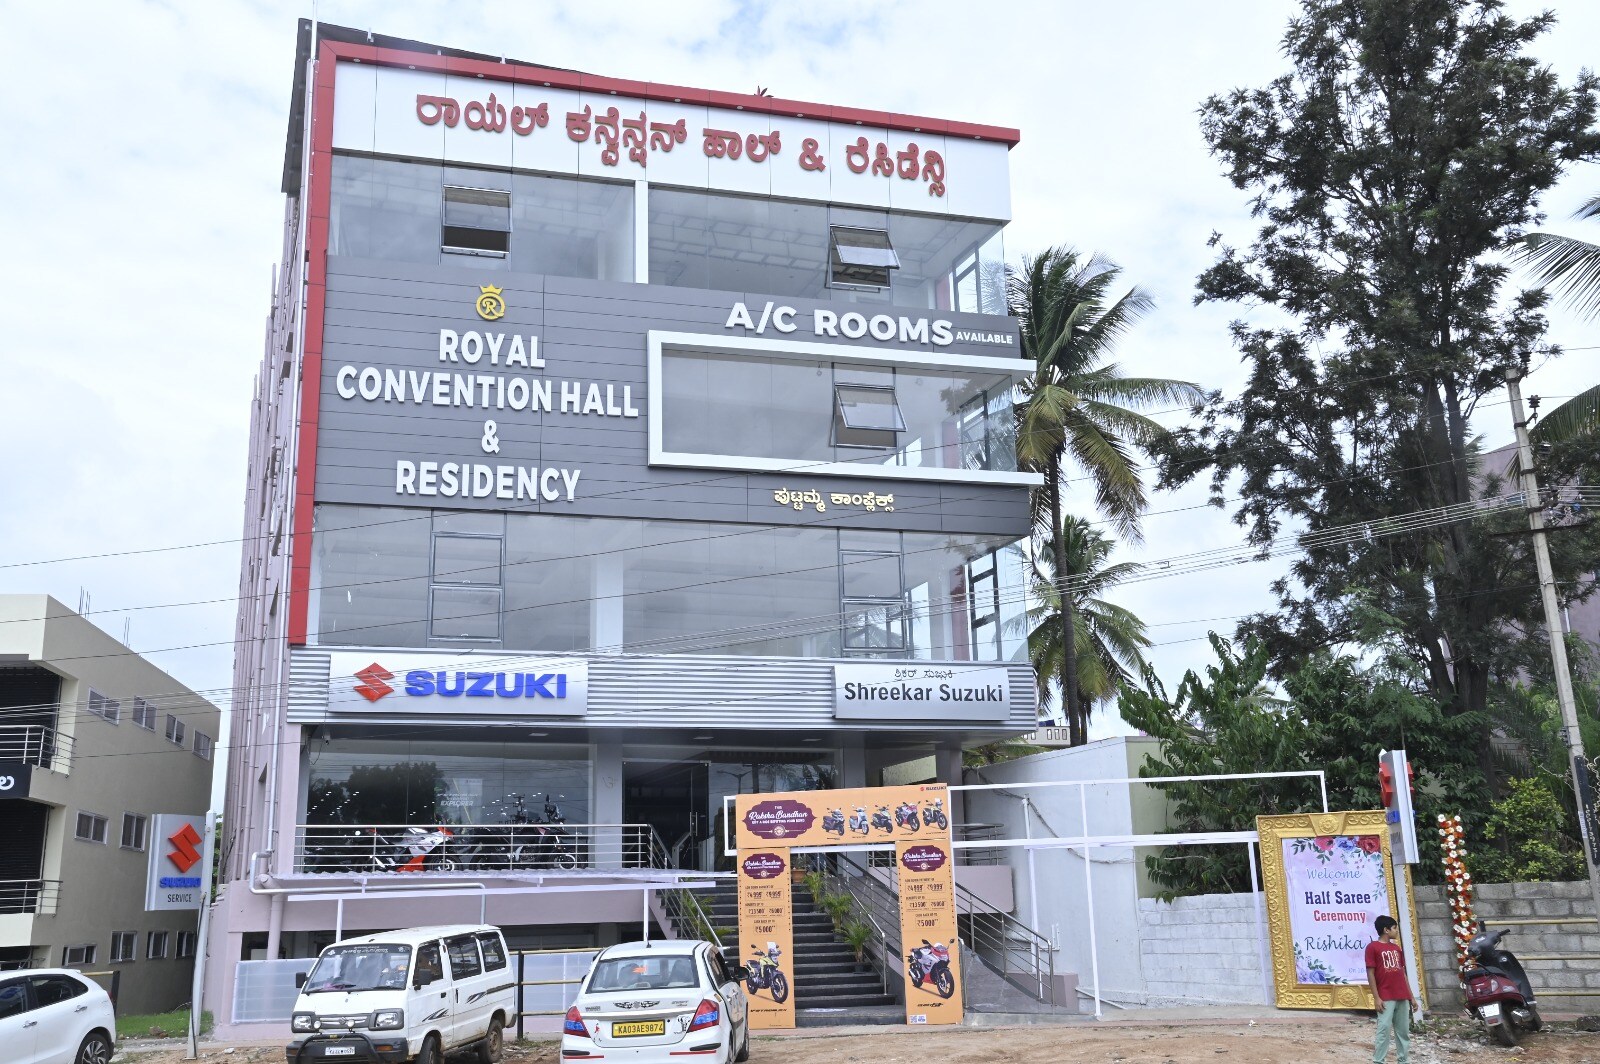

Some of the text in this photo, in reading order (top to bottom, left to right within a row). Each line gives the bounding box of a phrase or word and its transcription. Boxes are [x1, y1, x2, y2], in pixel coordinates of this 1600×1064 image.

[416, 93, 549, 136] ರಾಯಲ್
[703, 128, 781, 162] ಹಾಲ್
[799, 138, 826, 172] &
[846, 136, 945, 197] ರೆಸಿಡೆನ್ಸಿ
[725, 301, 1013, 346] A/C ROOMS AVAILABLE
[439, 328, 545, 368] ROYAL
[336, 365, 638, 417] CONVENTION HALL
[481, 419, 500, 454] &
[396, 460, 581, 502] RESIDENCY
[405, 670, 567, 699] SUZUKI
[844, 682, 1003, 702] Shreekar Suzuki
[748, 810, 808, 820] Raksha Bandhan
[1306, 868, 1363, 879] Welcome
[167, 894, 192, 902] SERVICE
[1305, 891, 1371, 904] Half Saree
[1313, 910, 1366, 923] Ceremony
[1304, 935, 1366, 951] Rishika
[618, 1022, 663, 1035] KA03AE9874
